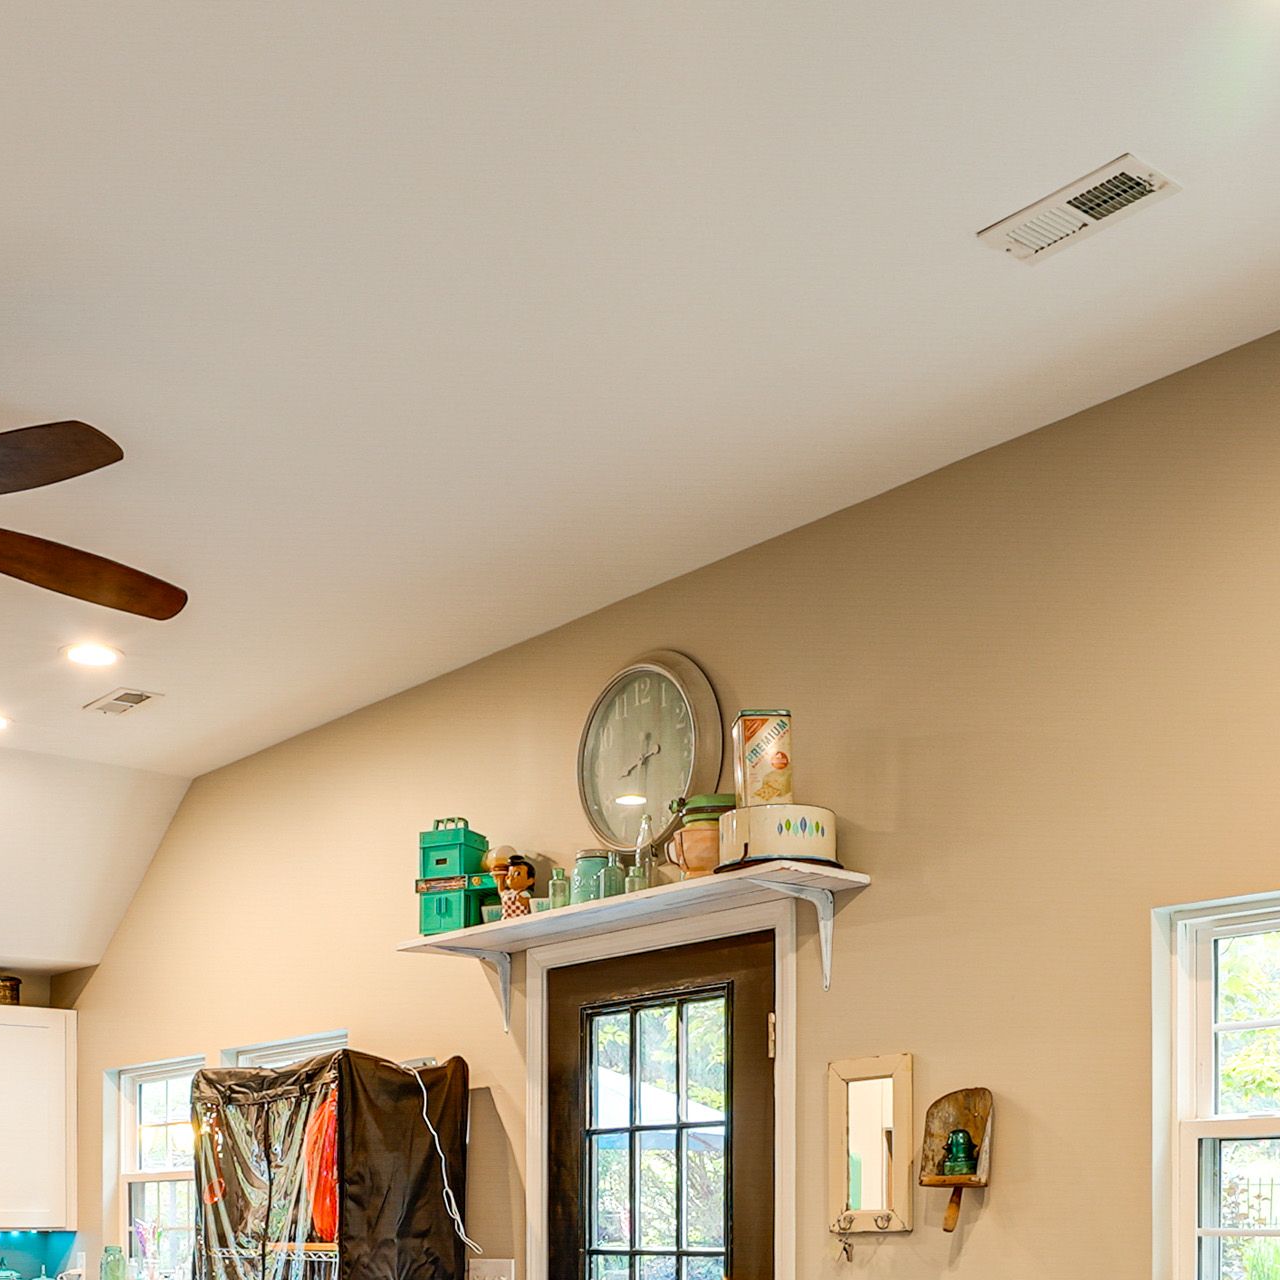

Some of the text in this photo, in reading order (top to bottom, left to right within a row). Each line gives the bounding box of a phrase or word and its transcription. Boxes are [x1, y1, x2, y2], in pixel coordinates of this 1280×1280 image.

[634, 677, 651, 706] 12
[660, 682, 667, 708] 1
[615, 693, 628, 720] 11
[675, 702, 686, 730] 2
[600, 725, 613, 751] 10
[745, 718, 789, 764] PREMIUM
